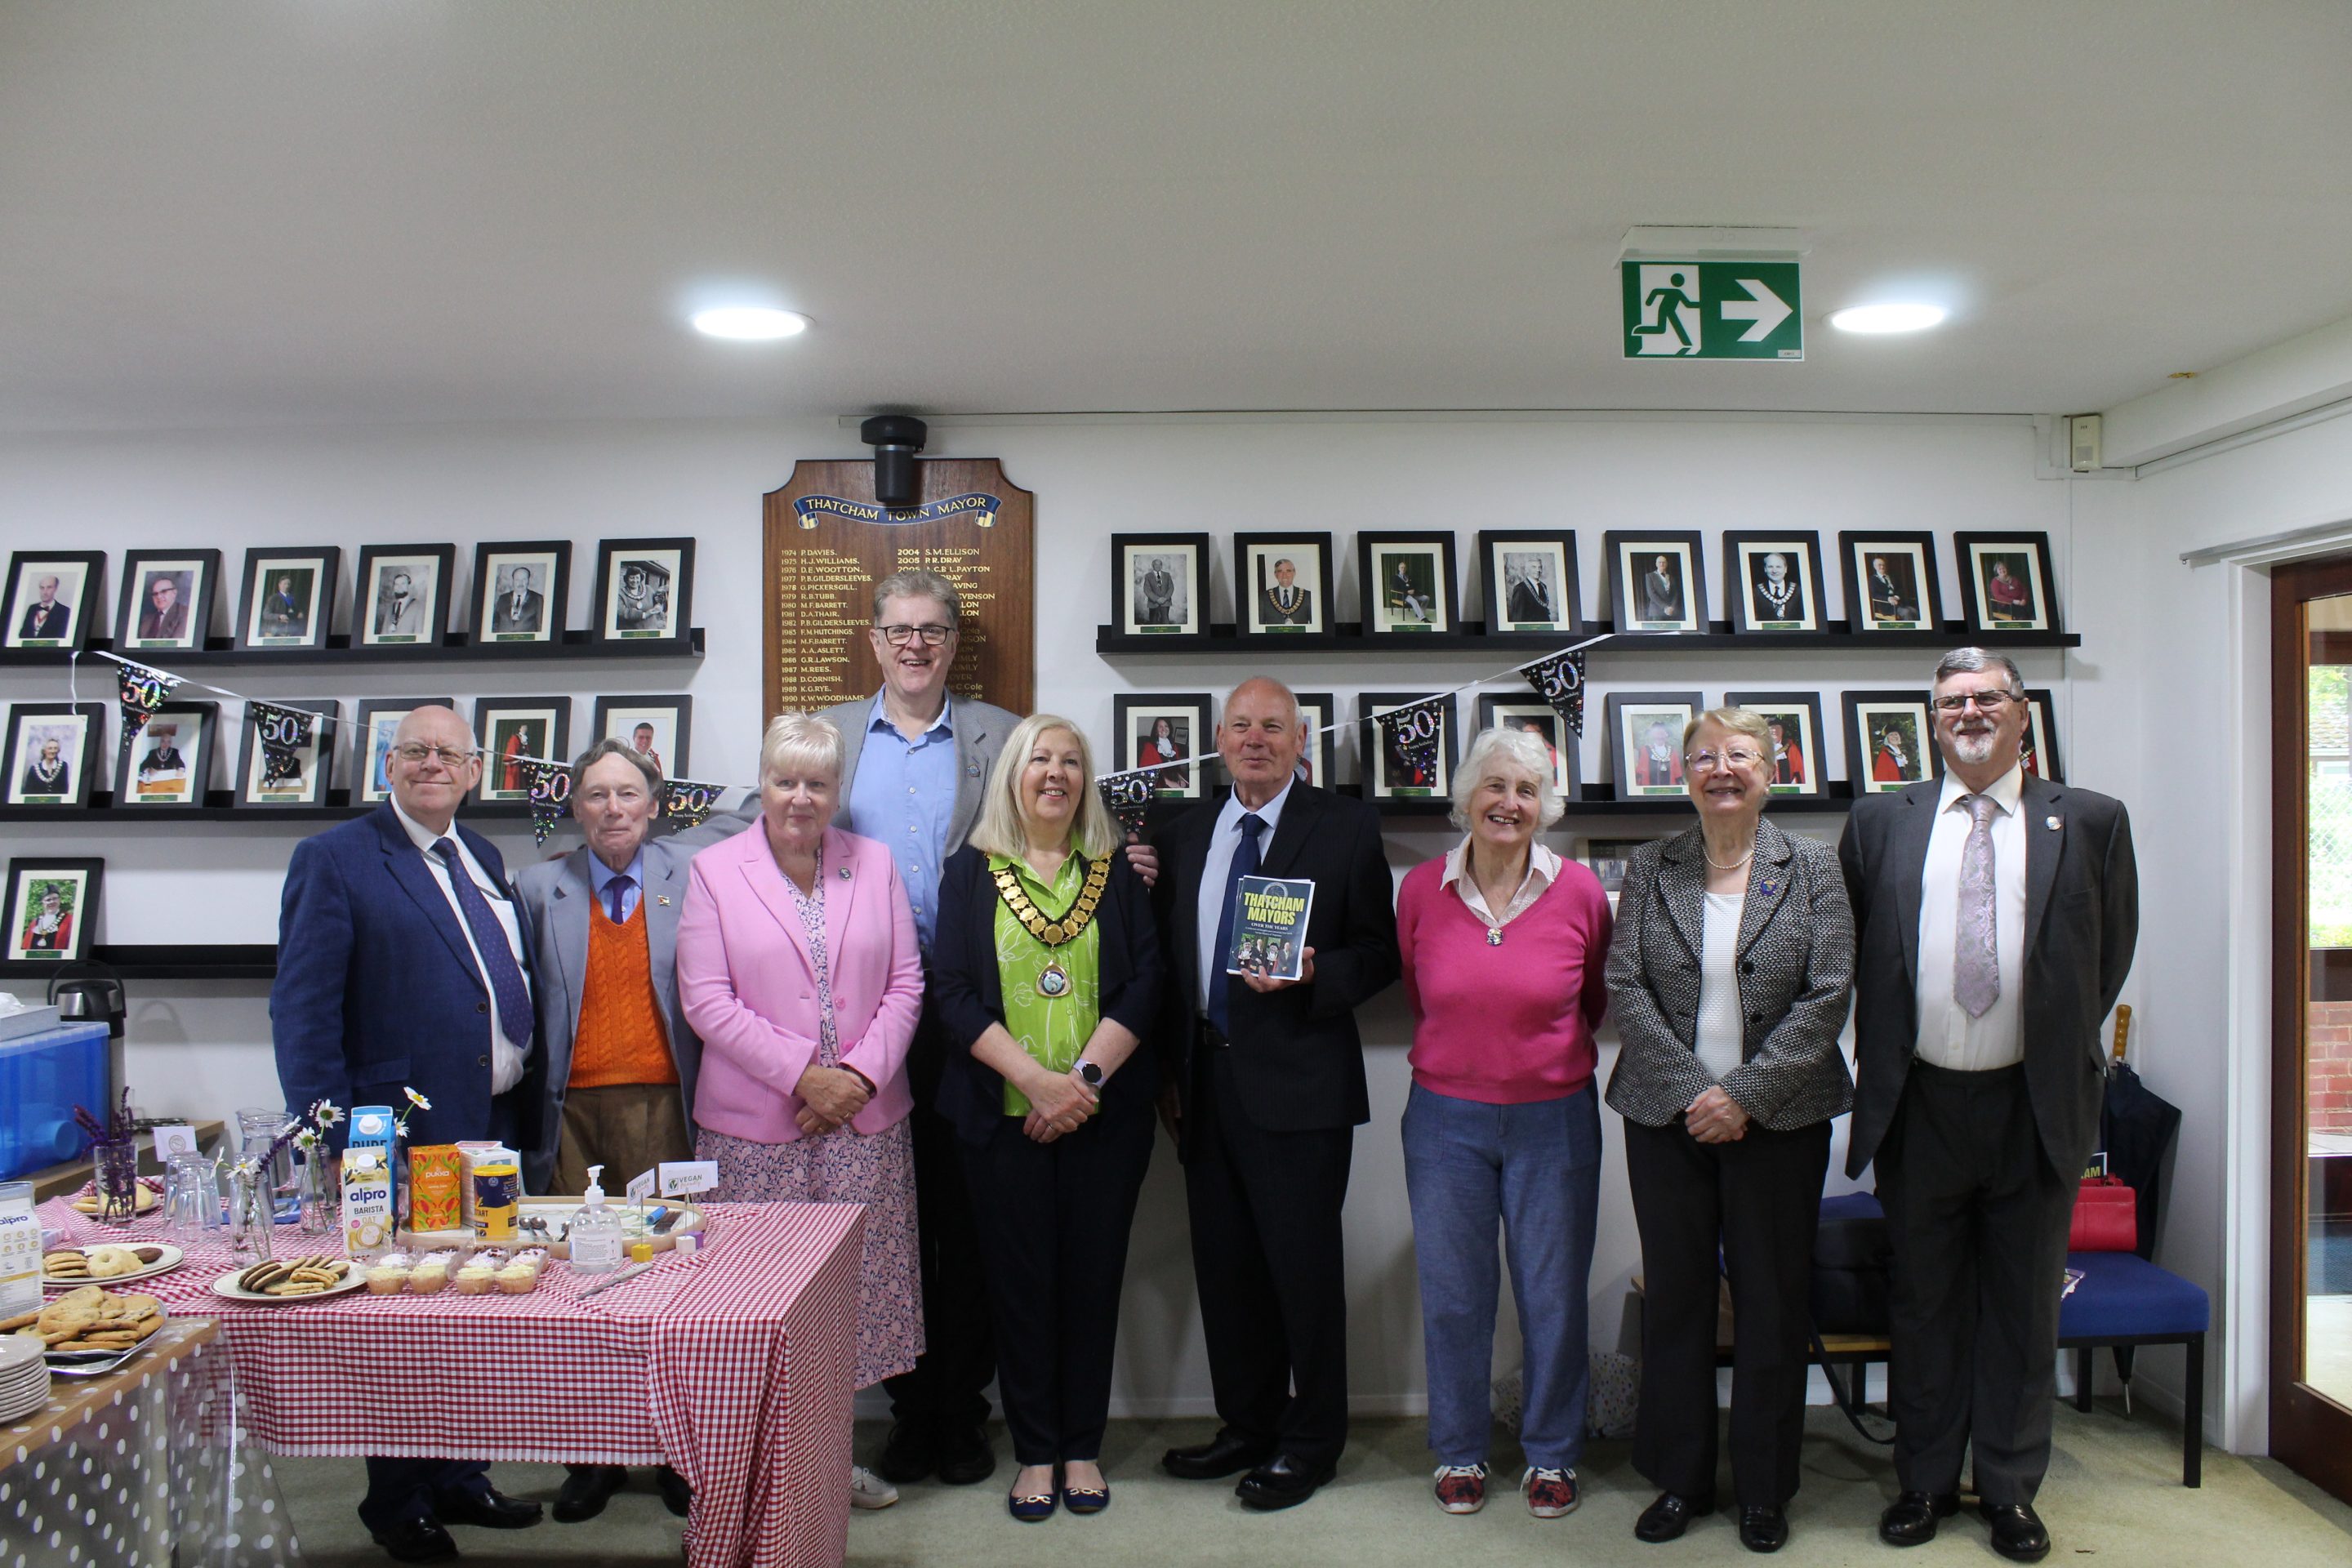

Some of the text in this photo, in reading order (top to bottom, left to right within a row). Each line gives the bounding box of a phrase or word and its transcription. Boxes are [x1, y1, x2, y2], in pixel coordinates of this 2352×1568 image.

[806, 497, 986, 521] THATCHAM TOWN MAYOR
[1541, 661, 1579, 696] 50
[121, 675, 160, 708] 50
[262, 712, 298, 745] 50
[1396, 710, 1435, 744] 50
[531, 770, 570, 802] 50
[1111, 779, 1147, 805] 50
[668, 787, 708, 812] 50
[1244, 892, 1305, 912] THATCHAM
[1247, 906, 1296, 926] MAYORS
[679, 1174, 702, 1183] VEGAN
[2081, 1166, 2100, 1179] AM
[350, 1187, 386, 1204] alpro
[354, 1205, 384, 1215] BARISTA
